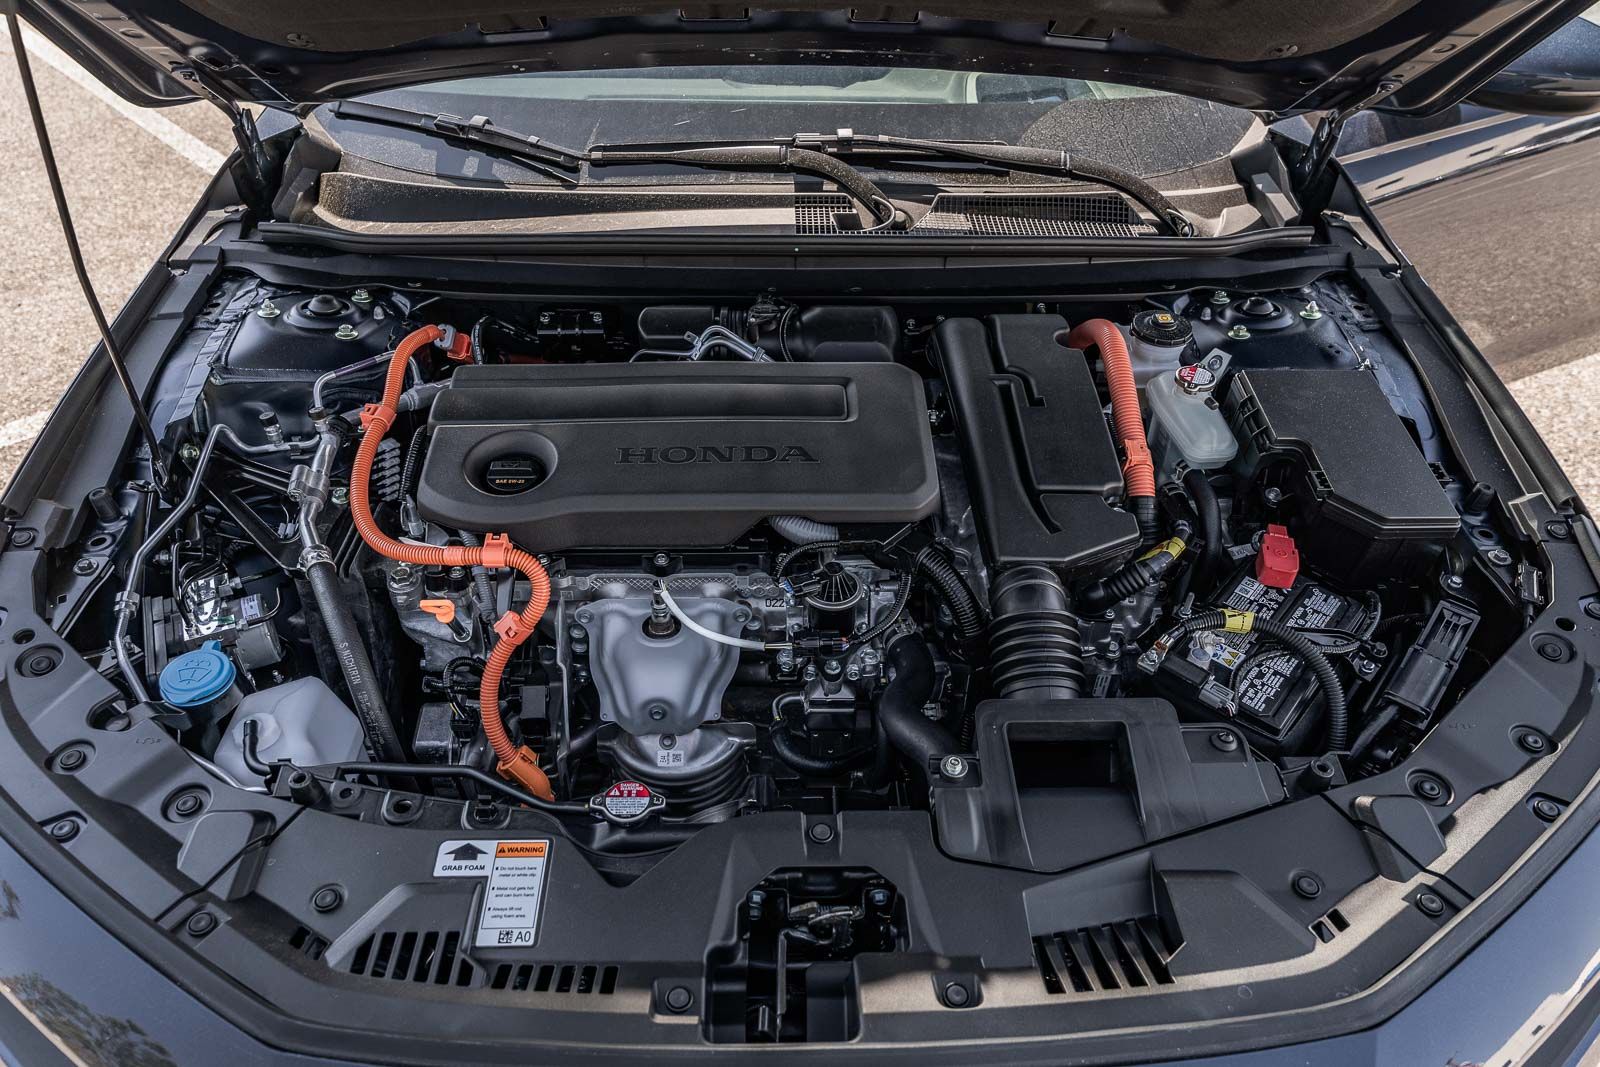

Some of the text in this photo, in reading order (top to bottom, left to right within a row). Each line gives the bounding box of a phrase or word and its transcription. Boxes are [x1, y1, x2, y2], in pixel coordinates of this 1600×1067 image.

[615, 445, 820, 464] HONDA
[765, 598, 784, 607] 022
[507, 846, 543, 854] WARNING
[515, 930, 531, 943] A0
